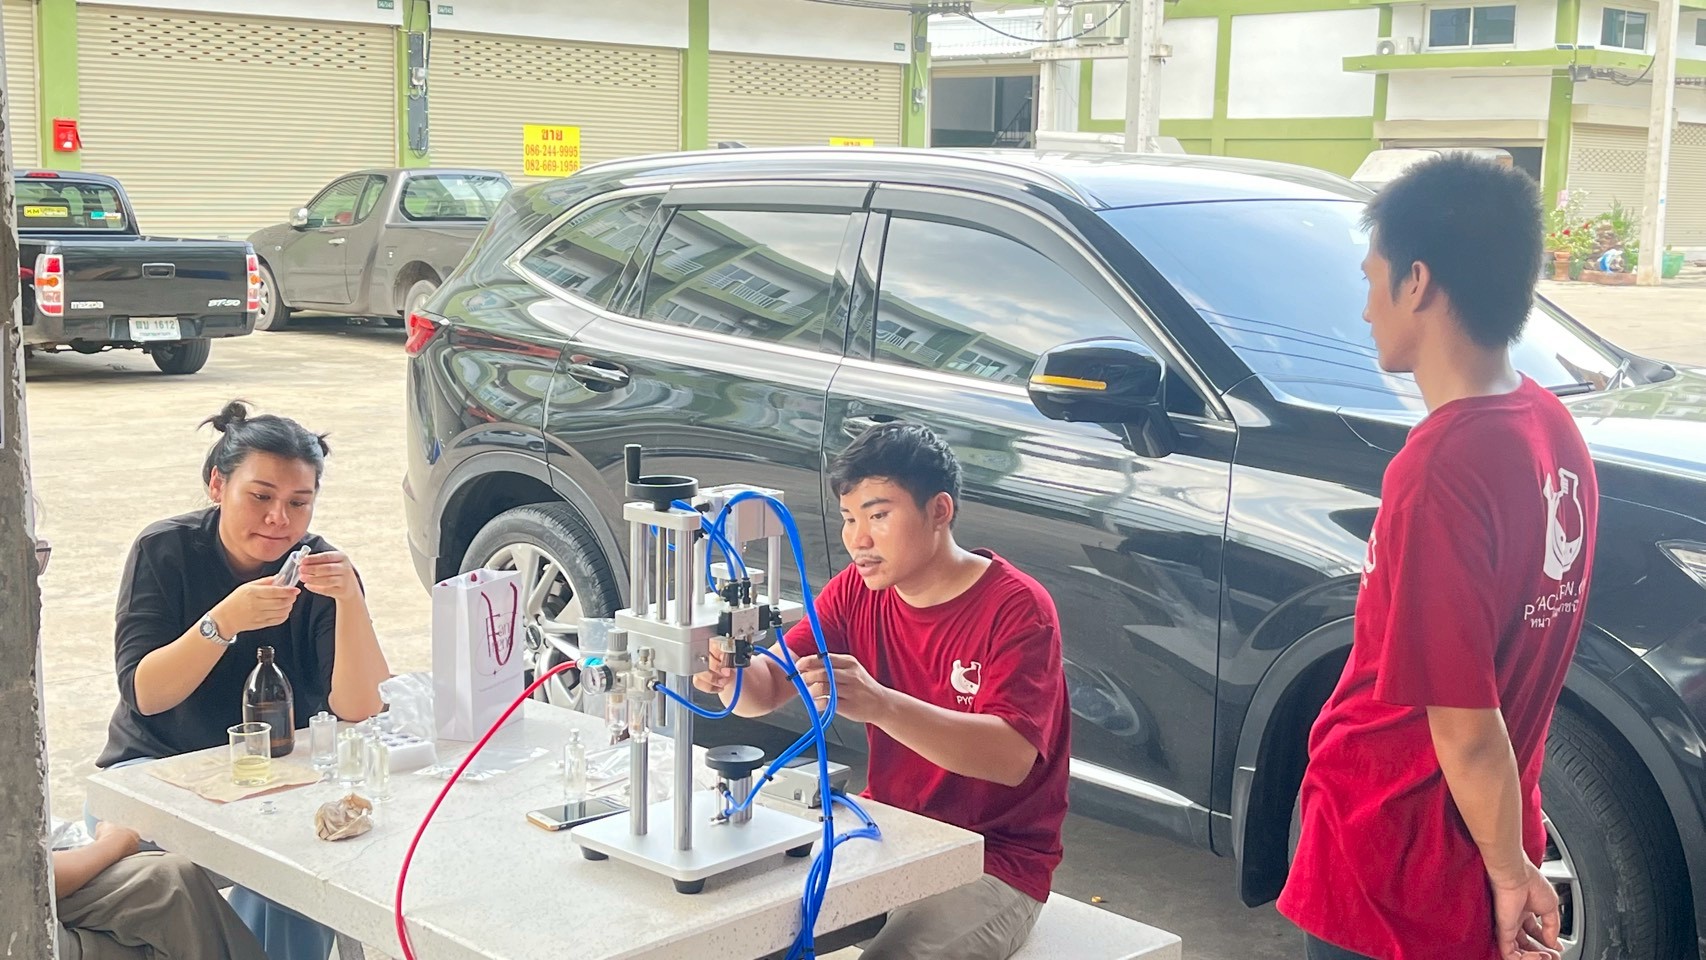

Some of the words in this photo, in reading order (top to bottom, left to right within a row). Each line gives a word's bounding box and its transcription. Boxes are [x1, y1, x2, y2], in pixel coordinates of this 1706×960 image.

[541, 129, 563, 141] ขาย
[525, 143, 578, 157] 086-244-9995
[525, 159, 578, 172] 082-669-1956
[71, 301, 104, 309] mazda
[208, 299, 241, 307] BT-50
[154, 320, 176, 330] 1612
